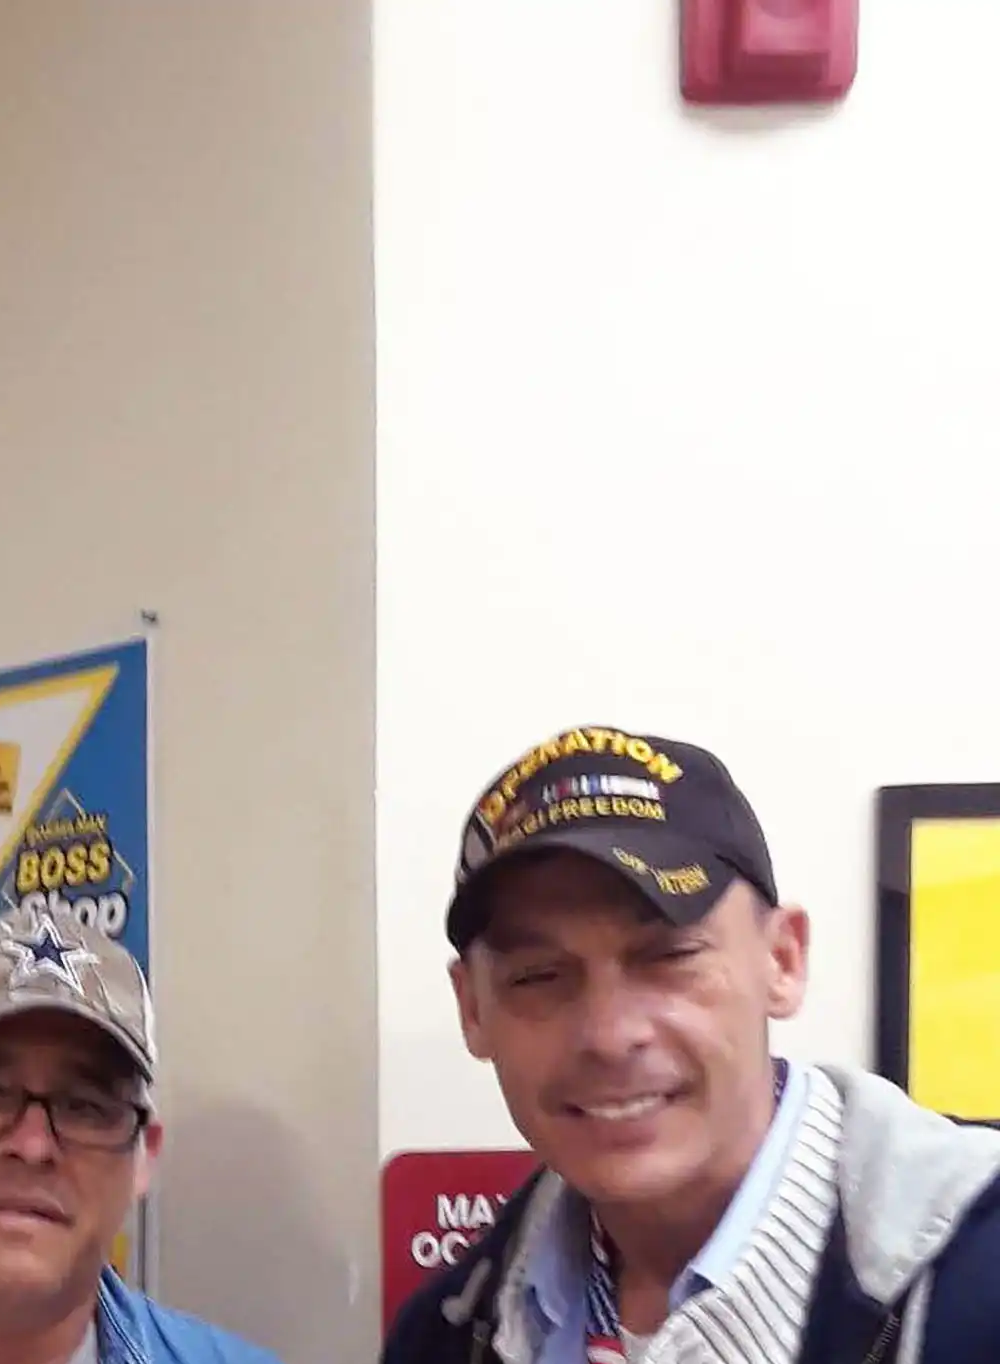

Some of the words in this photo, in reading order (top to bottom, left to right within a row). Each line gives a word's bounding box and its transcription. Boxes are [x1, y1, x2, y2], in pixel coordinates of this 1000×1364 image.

[548, 797, 666, 825] FREEDOM
[17, 841, 111, 893] BOSS
[437, 1193, 507, 1229] MA
